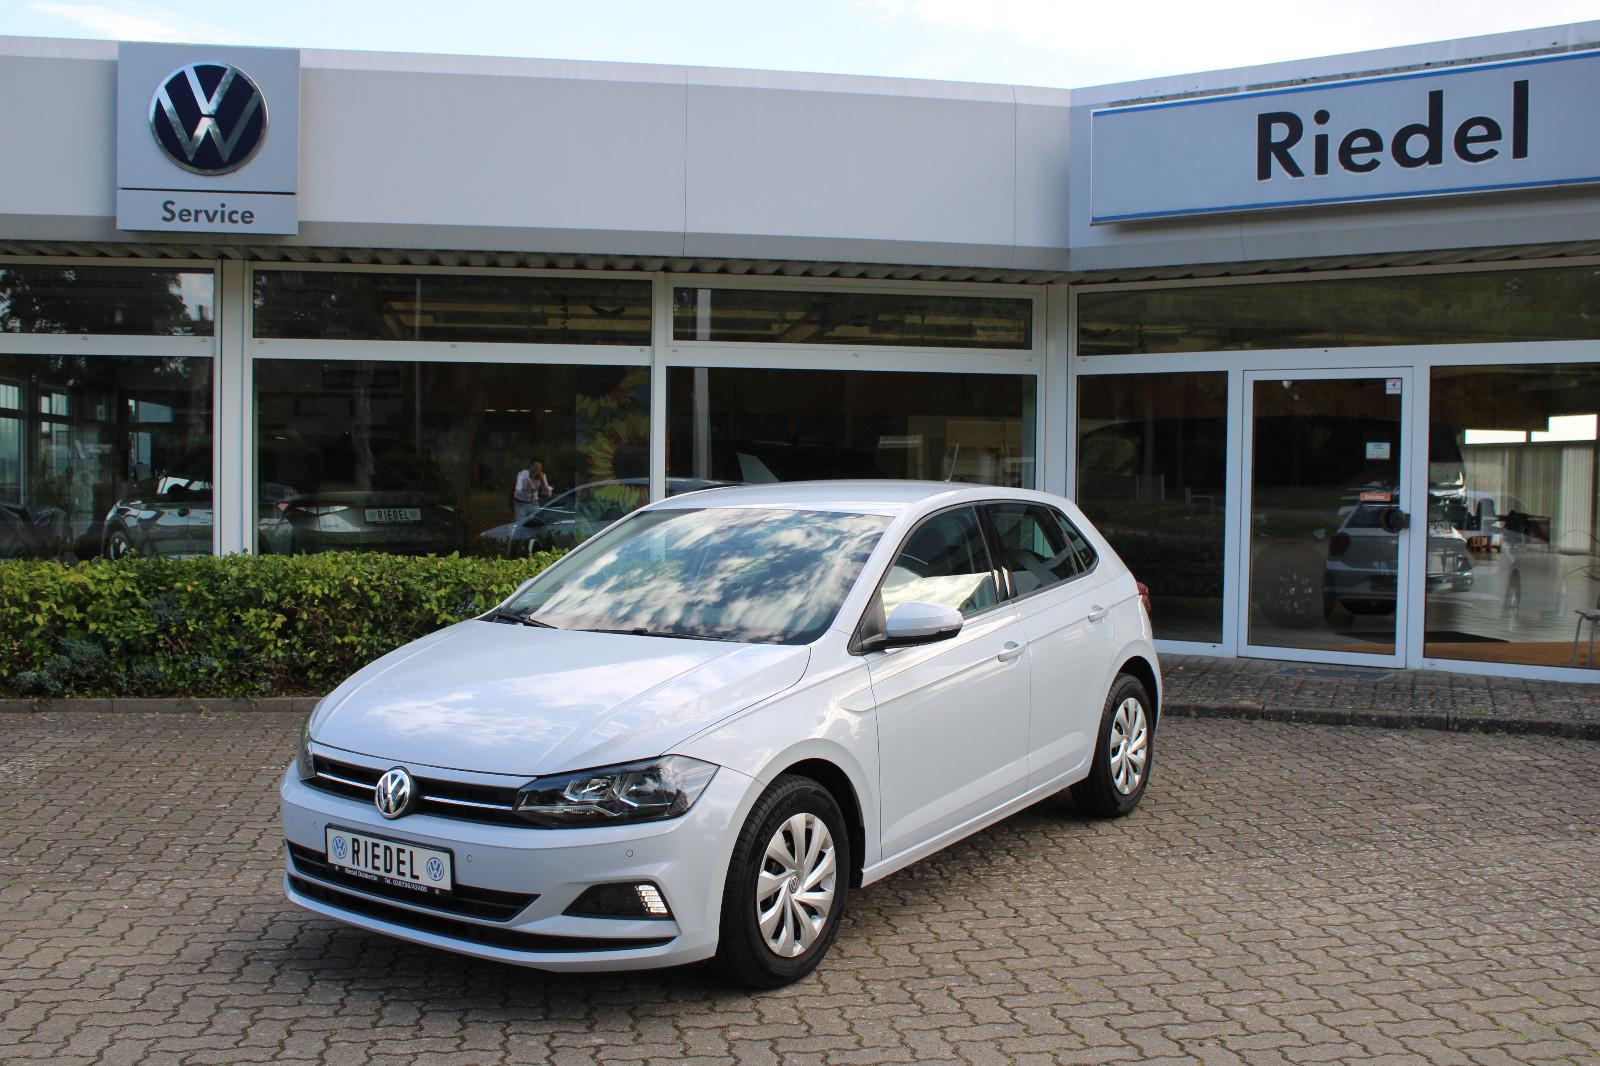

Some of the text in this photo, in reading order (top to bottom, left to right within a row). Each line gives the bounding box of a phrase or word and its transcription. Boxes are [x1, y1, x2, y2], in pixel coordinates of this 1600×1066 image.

[1256, 80, 1529, 181] Riedel
[162, 199, 255, 226] Service
[377, 510, 409, 520] RIEDEL
[352, 838, 419, 880] RIEDEL
